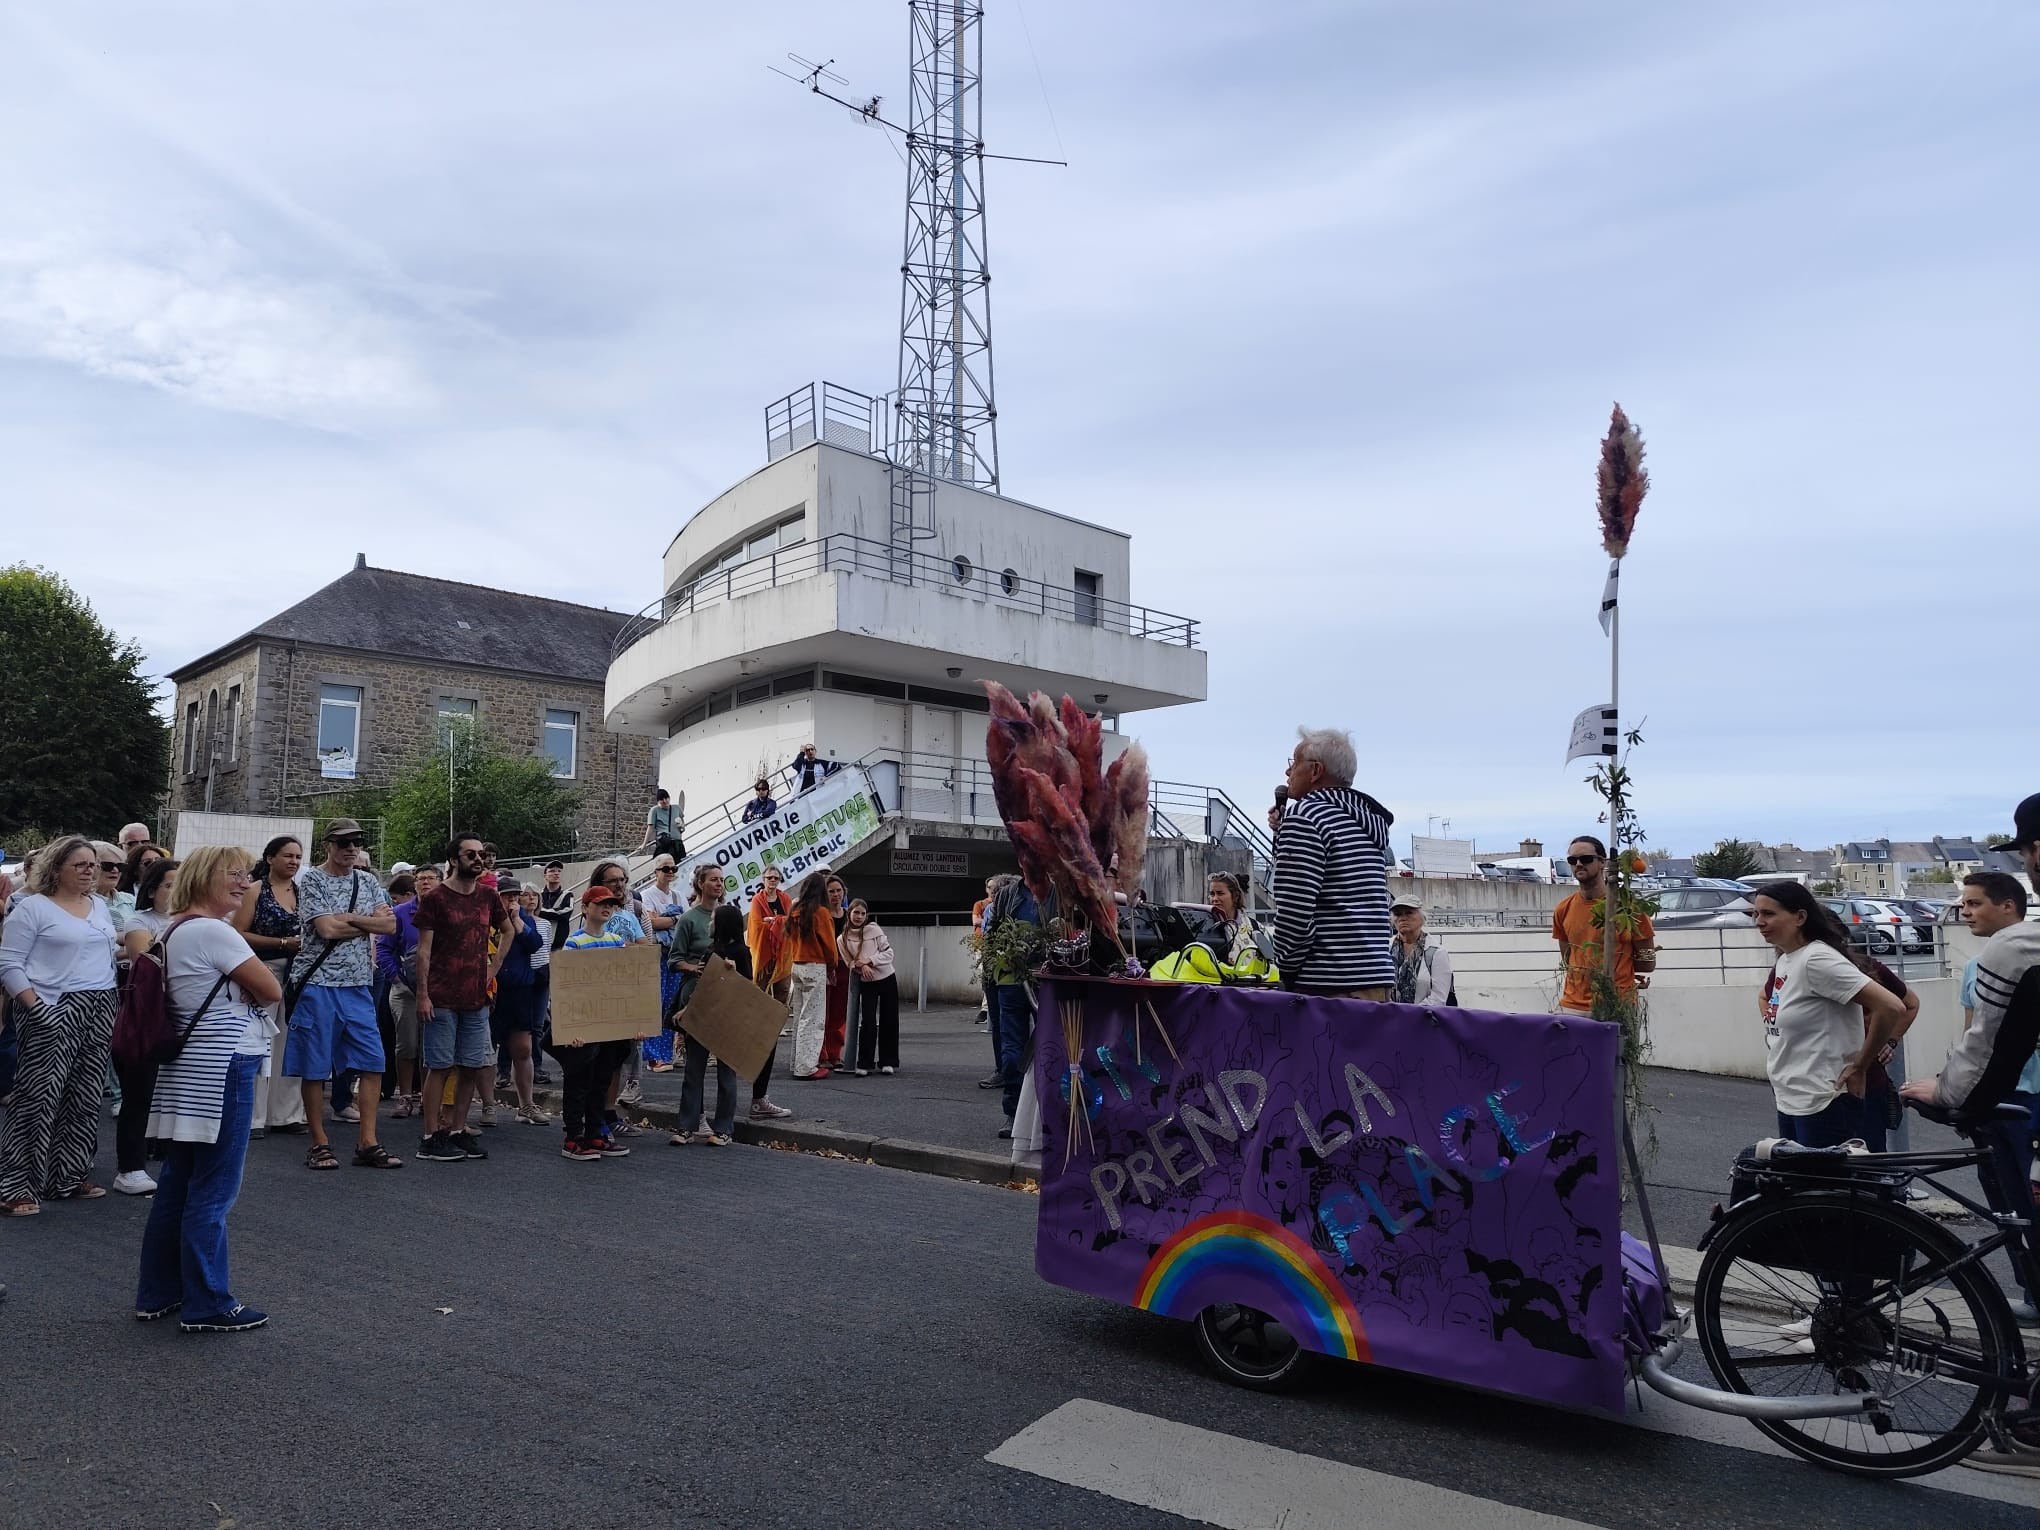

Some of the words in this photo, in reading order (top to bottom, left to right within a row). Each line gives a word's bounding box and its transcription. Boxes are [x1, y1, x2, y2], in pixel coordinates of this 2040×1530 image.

[716, 819, 783, 866] OUVRIR
[784, 811, 800, 828] le
[738, 861, 761, 884] la
[760, 792, 867, 867] PRÉFECTURE
[893, 863, 928, 872] CIRCULATION
[930, 864, 950, 873] DOUBLE
[952, 865, 967, 873] SENS
[894, 852, 919, 861] ALLUMEZ
[922, 853, 934, 862] VOS
[936, 854, 966, 862] LANTERNES
[1090, 1070, 1267, 1230] PREND
[1296, 1063, 1395, 1158] LA
[1318, 1080, 1555, 1266] PLACE
